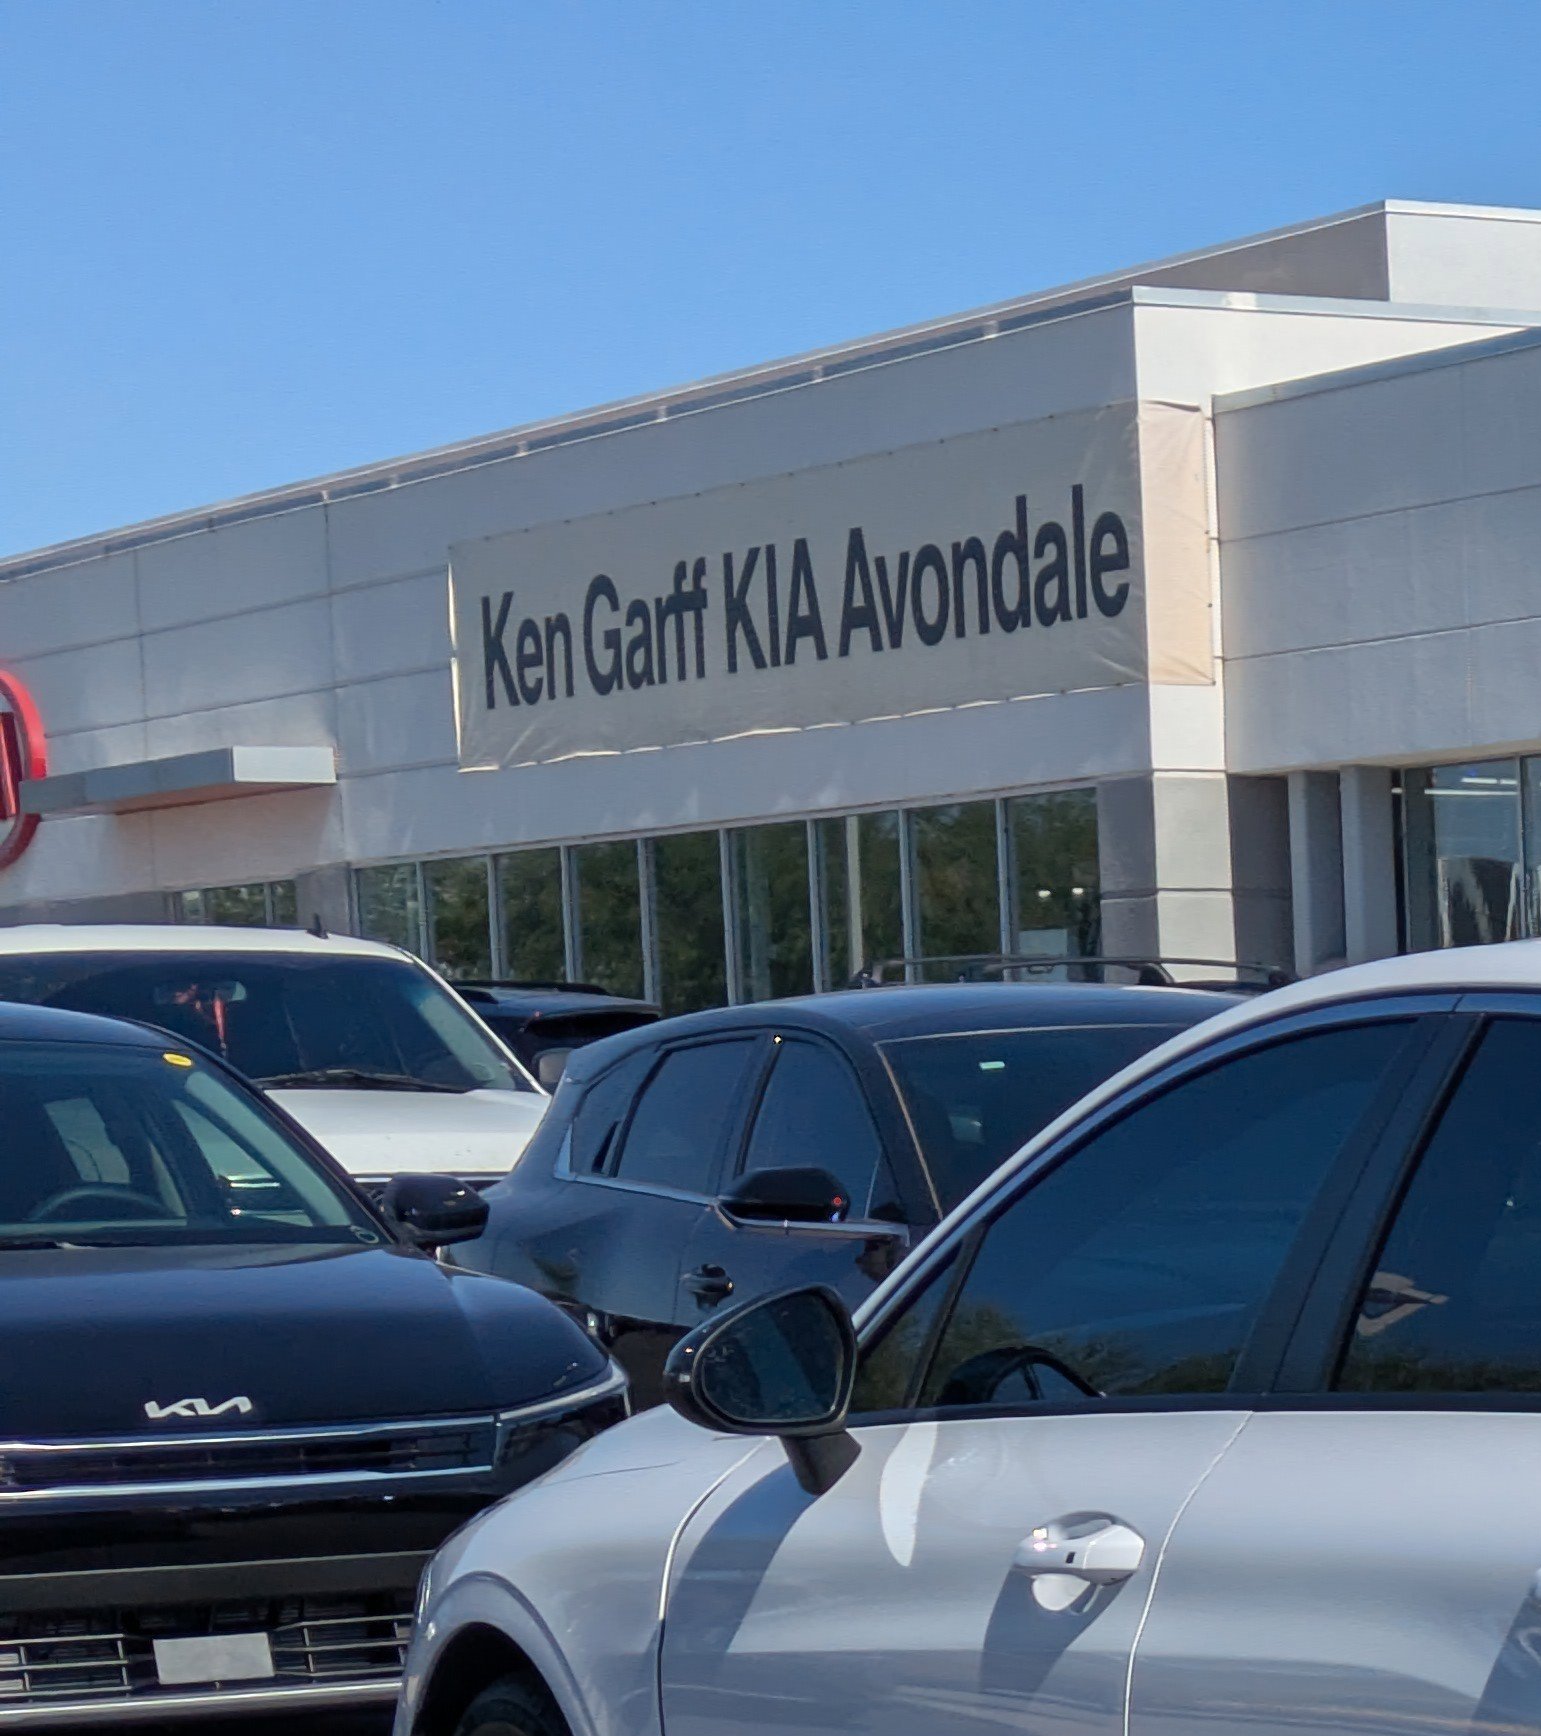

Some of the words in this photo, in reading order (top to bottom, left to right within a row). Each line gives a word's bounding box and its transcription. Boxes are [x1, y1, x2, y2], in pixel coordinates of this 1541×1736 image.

[482, 590, 574, 711] Ken
[583, 556, 708, 696] Garff
[722, 537, 828, 674] KIA
[838, 484, 1131, 658] Avondale
